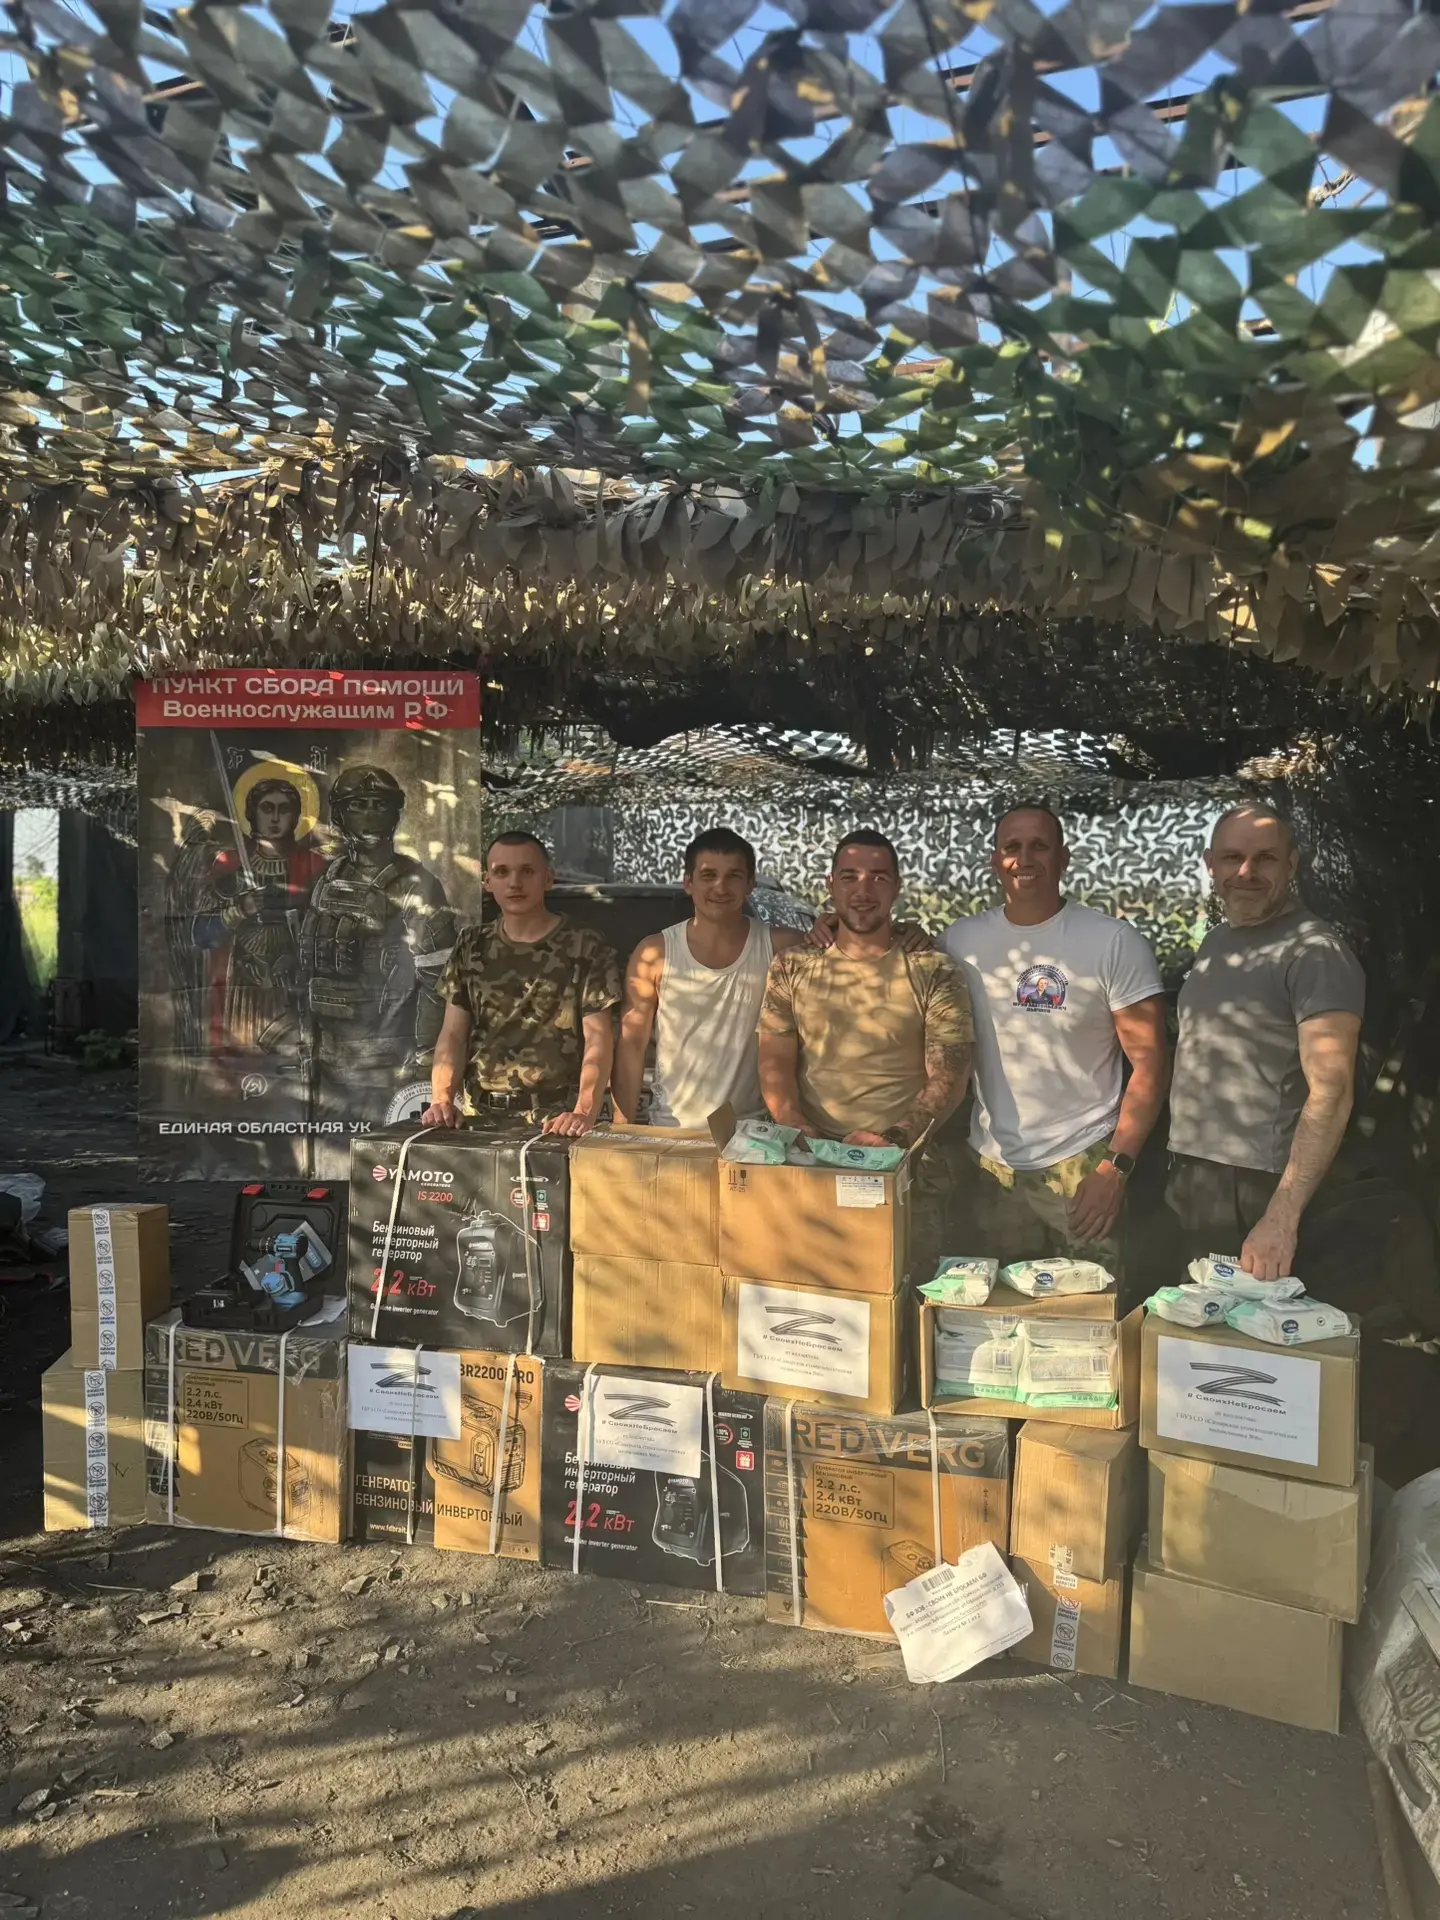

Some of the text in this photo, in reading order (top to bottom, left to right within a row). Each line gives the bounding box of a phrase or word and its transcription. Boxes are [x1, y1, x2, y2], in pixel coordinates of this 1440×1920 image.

[152, 677, 464, 697] ПУНКТ СБОРА ПОМОЩИ
[163, 700, 449, 722] Военнослужащим РФ
[159, 1122, 372, 1135] ЕДИНАЯ ОБЛАСТНАЯ УК
[388, 1168, 454, 1184] YAMOTO
[417, 1191, 453, 1203] IS 2200
[372, 1236, 439, 1250] инерторный
[407, 1280, 436, 1298] кВт
[166, 1335, 322, 1373] REDVEG
[187, 1387, 222, 1399] 2.2 л.с.
[376, 1389, 439, 1399] СвоихНеБосаем
[187, 1398, 223, 1410] 2.4 кВт
[187, 1410, 244, 1424] 220В/50Гц
[565, 1467, 636, 1483] инерторный
[565, 1480, 618, 1496] геератор
[816, 1479, 861, 1494] 2.2 л.с.
[816, 1491, 862, 1507] 2.4 кВт
[816, 1504, 888, 1524] 220В/50Гц
[604, 1514, 635, 1532] кВт
[611, 1541, 638, 1551] generator
